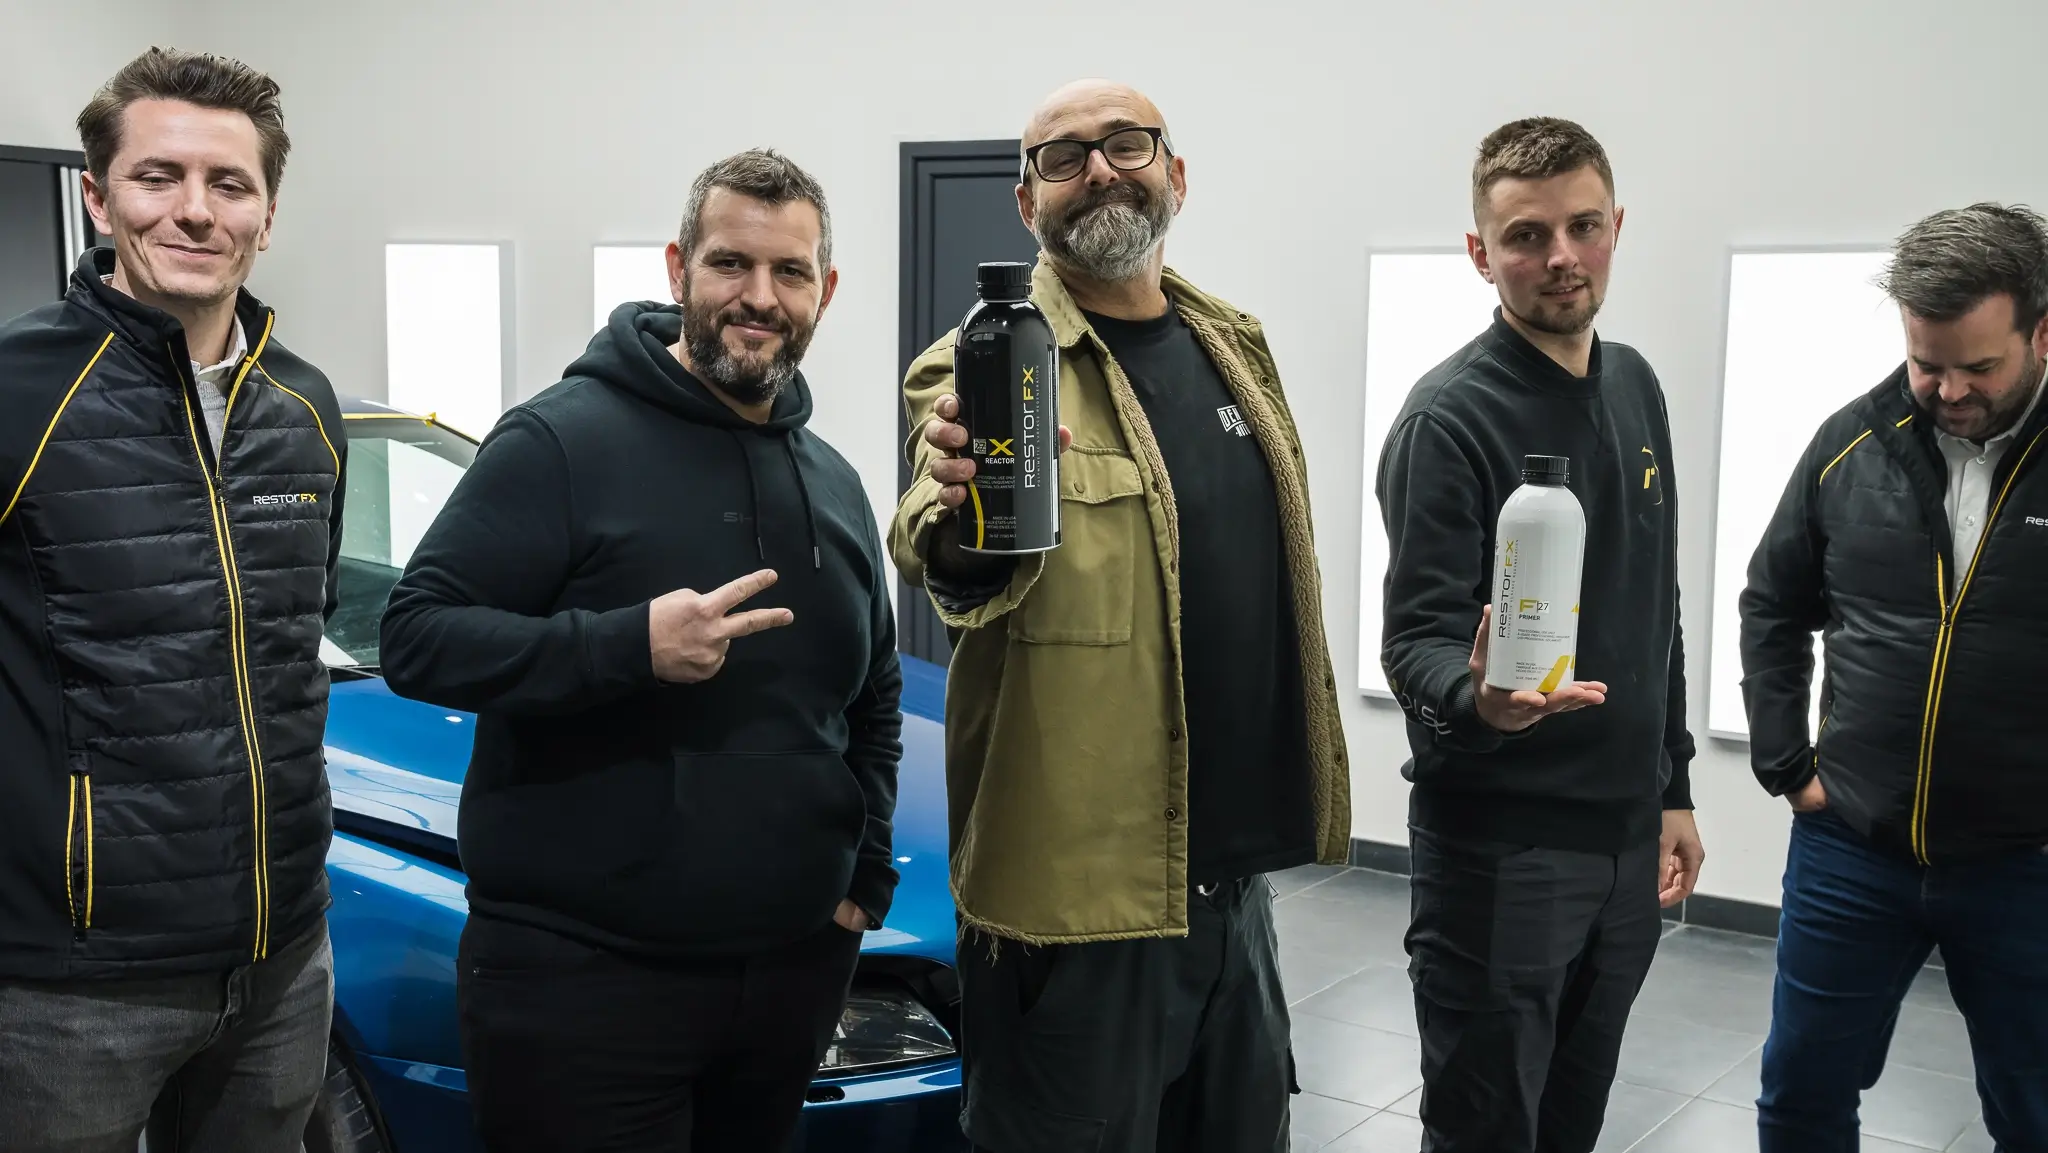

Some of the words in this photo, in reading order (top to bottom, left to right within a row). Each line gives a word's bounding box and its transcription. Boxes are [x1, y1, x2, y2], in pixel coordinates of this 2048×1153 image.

[988, 438, 1015, 456] X
[1537, 602, 1549, 611] 27
[1518, 613, 1541, 621] PRIMER
